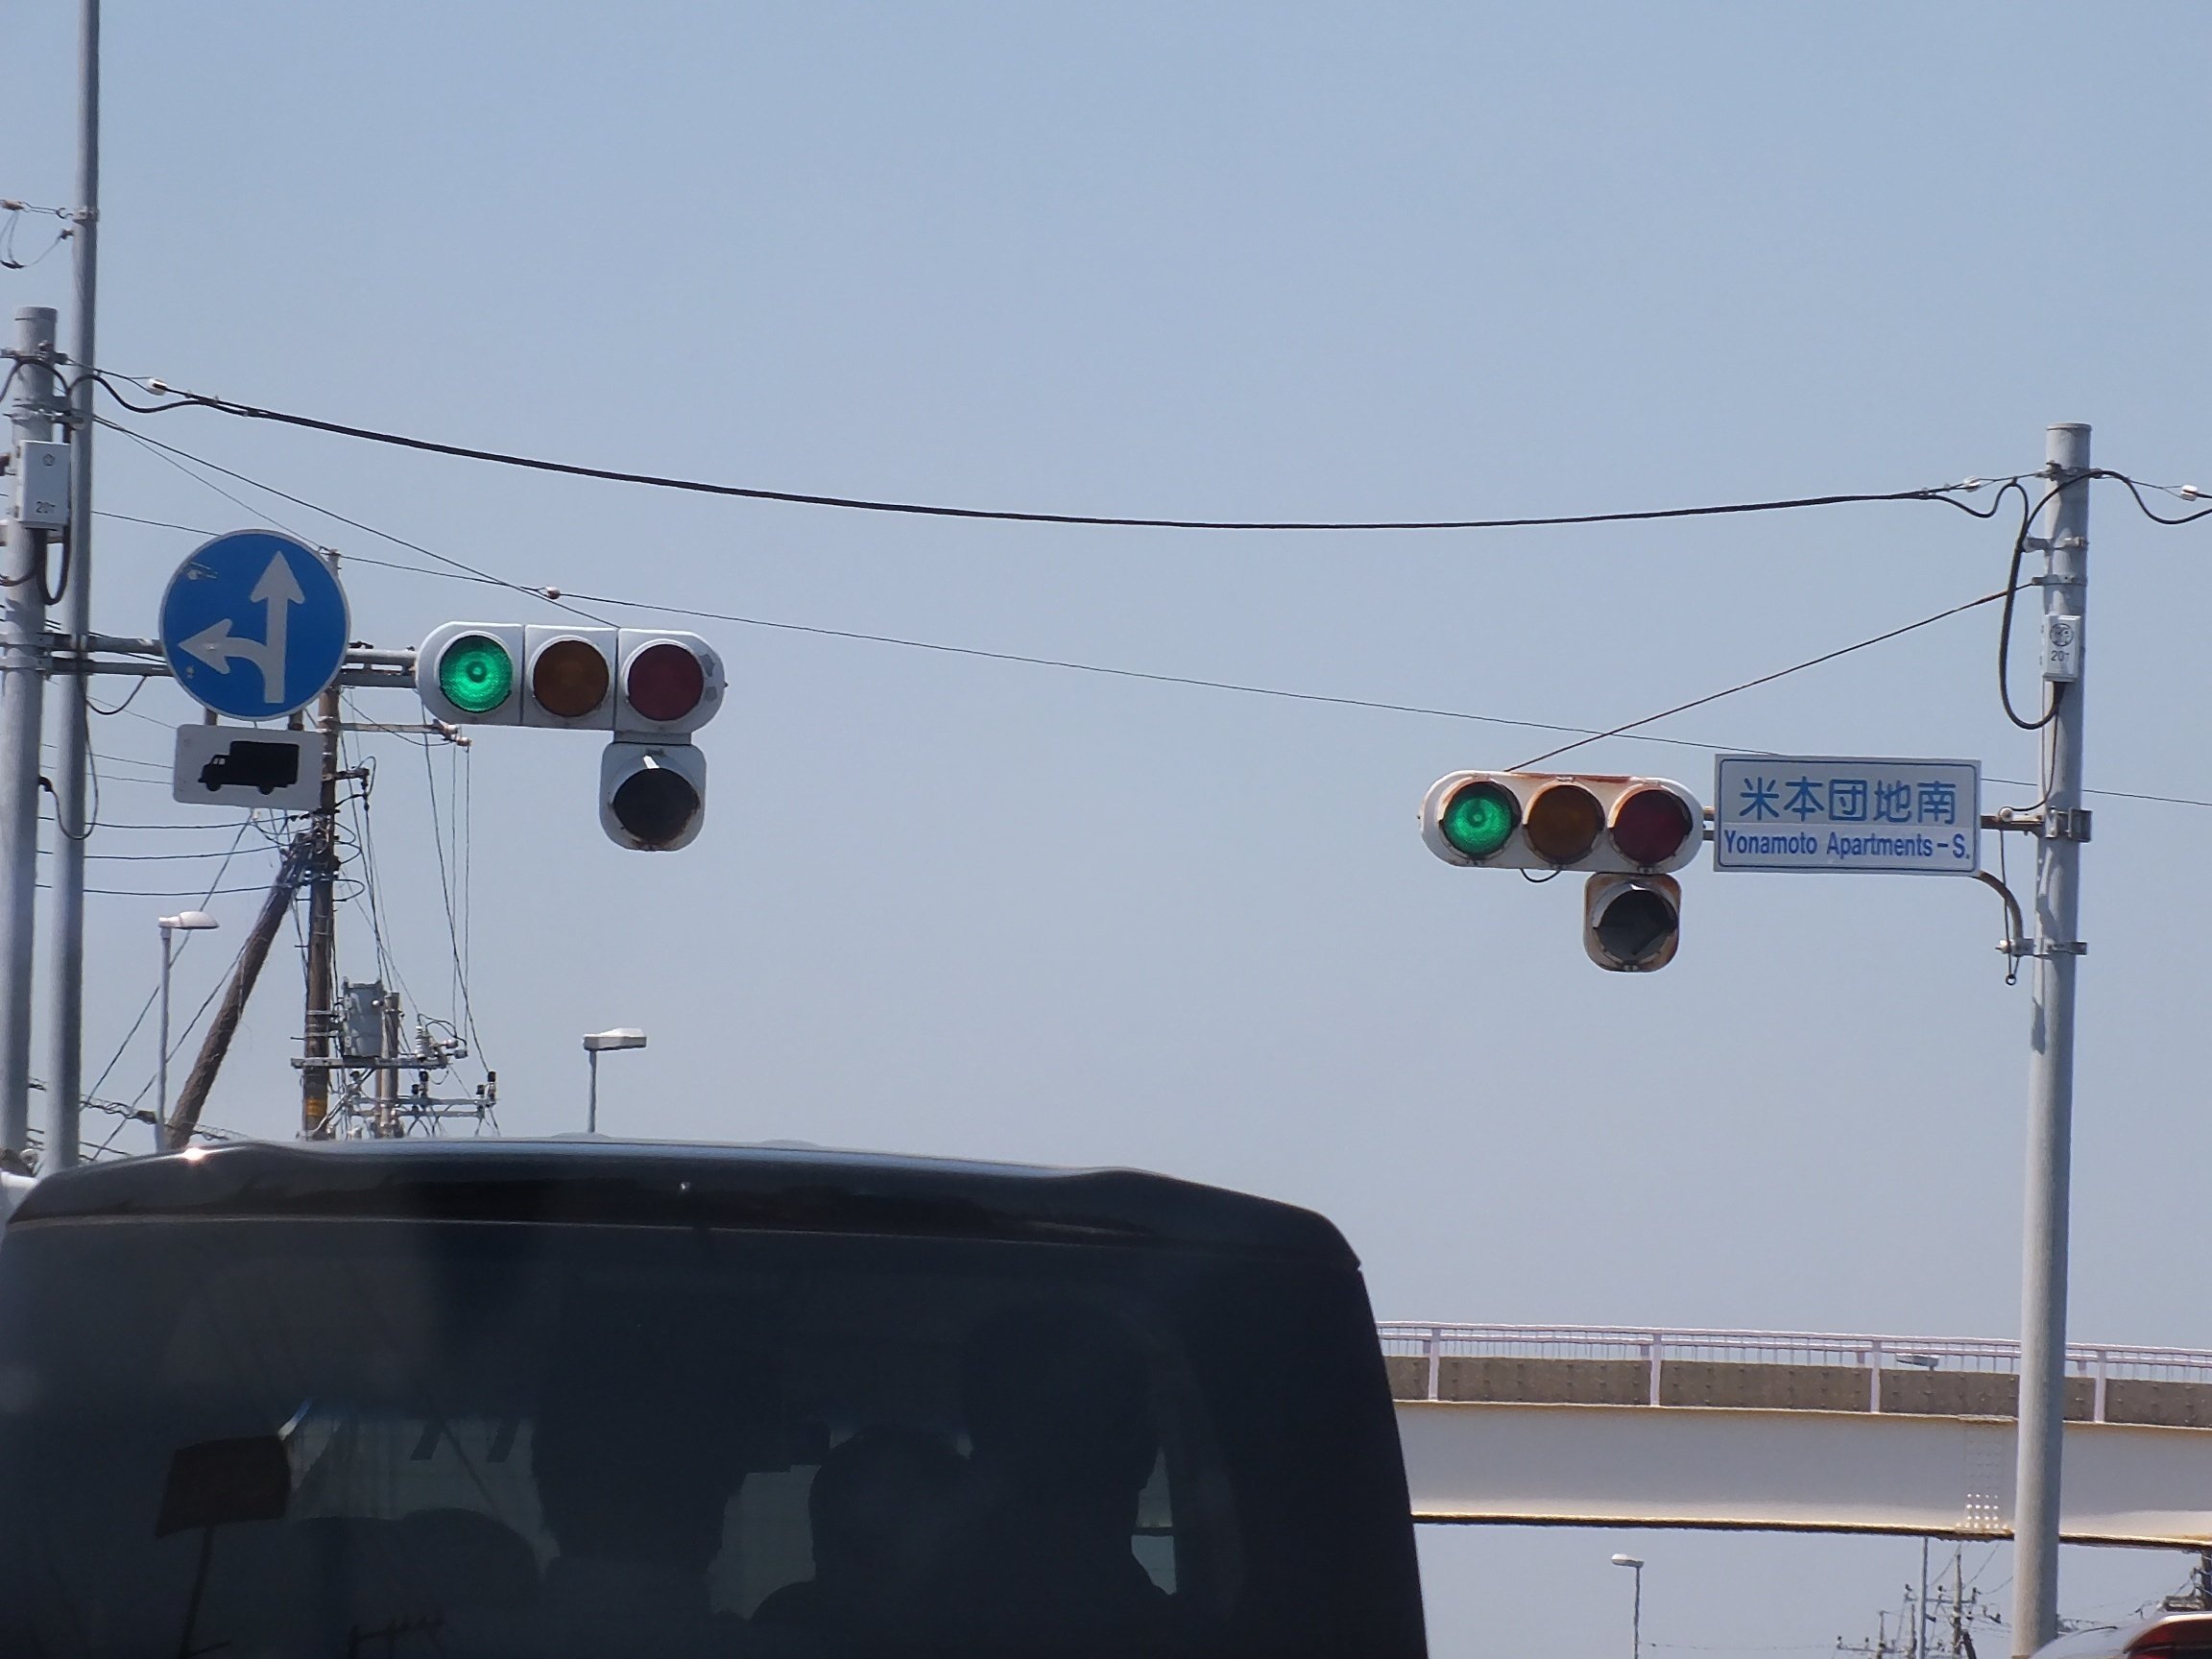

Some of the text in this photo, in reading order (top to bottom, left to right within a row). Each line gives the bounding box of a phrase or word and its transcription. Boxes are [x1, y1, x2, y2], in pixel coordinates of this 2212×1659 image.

[1739, 776, 1957, 825] 米本団地南
[1724, 830, 1817, 854] Yonamoto
